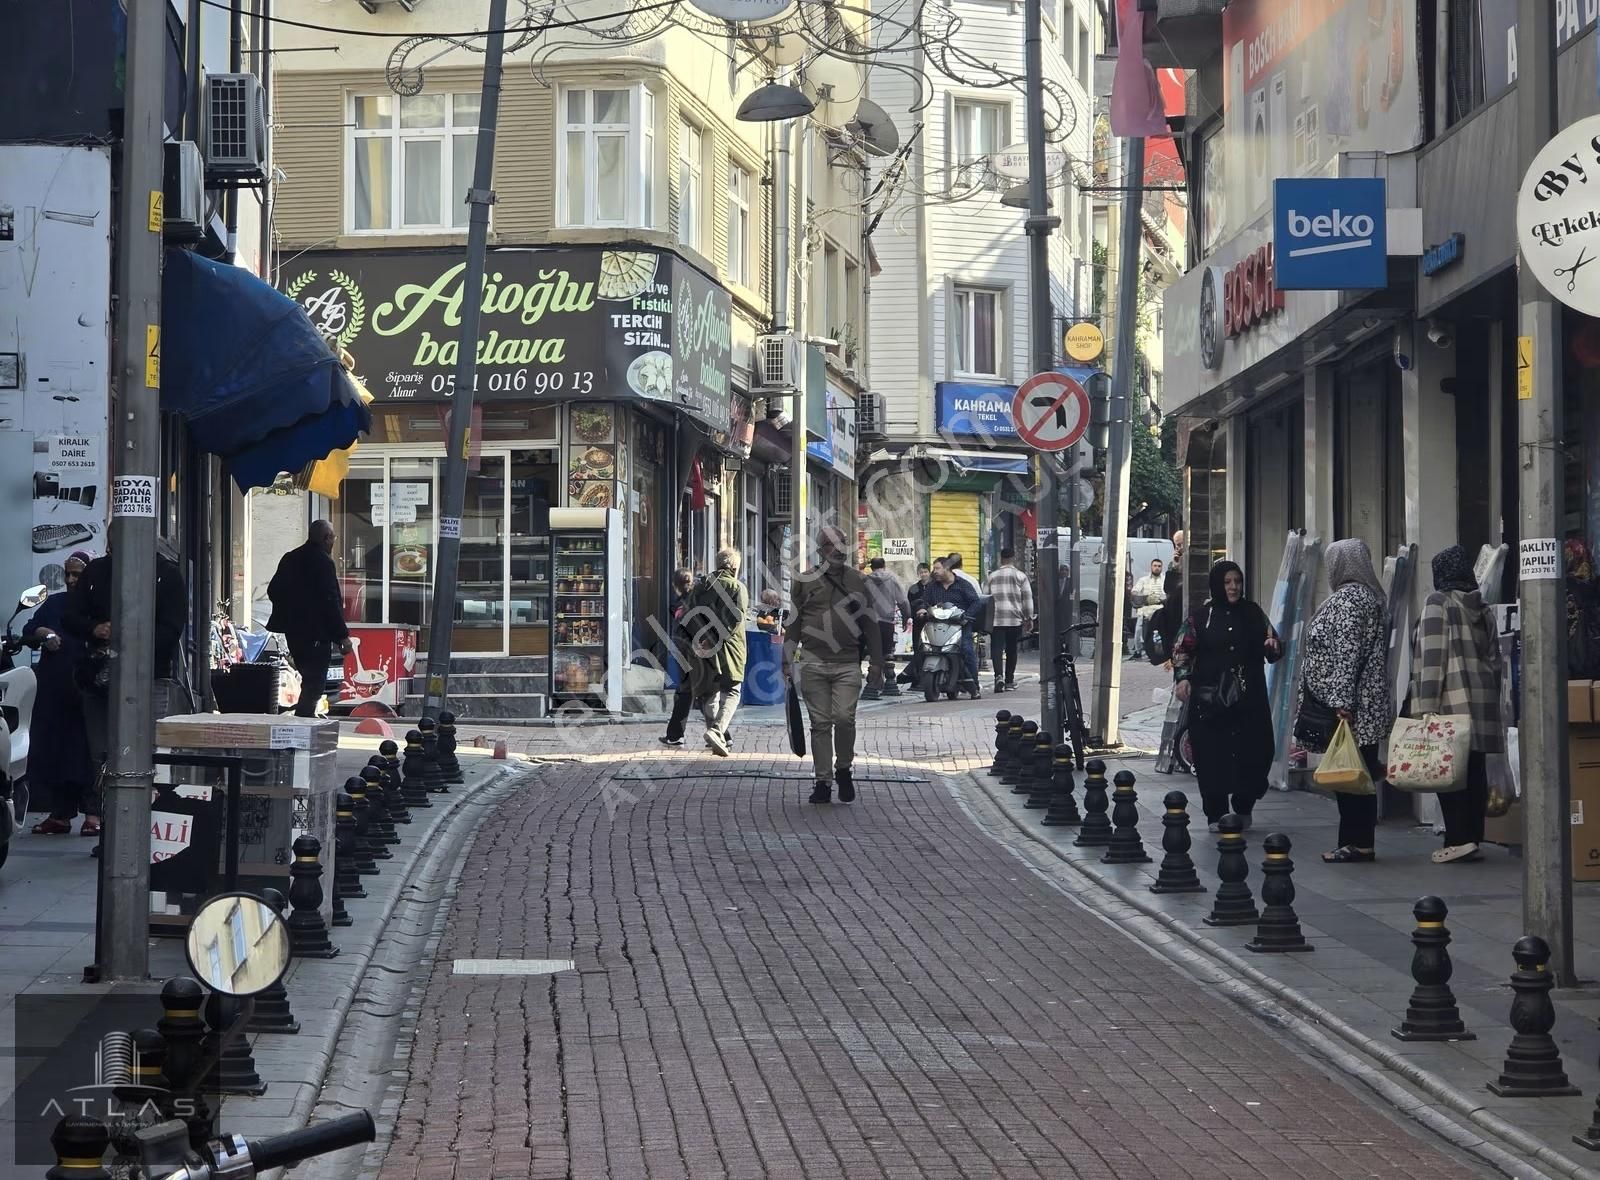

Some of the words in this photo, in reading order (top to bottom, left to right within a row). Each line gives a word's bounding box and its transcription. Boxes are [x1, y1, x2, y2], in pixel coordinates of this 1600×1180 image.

[1249, 23, 1276, 80] BOSCH
[1534, 153, 1588, 203] By
[1288, 208, 1374, 237] beko
[1224, 242, 1276, 337] BOSCH
[371, 262, 595, 336] Aioğlu
[1066, 335, 1101, 343] KAHRAMAN
[385, 371, 424, 387] Sipariş
[431, 373, 478, 397] 051
[488, 369, 527, 392] 016
[535, 371, 564, 395] 90
[571, 371, 594, 394] 13
[954, 398, 1012, 413] KAHRAMA
[977, 413, 998, 421] TEKEL
[58, 436, 90, 447] KİRALIK
[61, 447, 87, 458] DAİRE
[51, 460, 67, 468] 0507
[67, 460, 80, 468] 653
[114, 479, 152, 488] BOYA
[114, 488, 152, 497] BADANA
[114, 495, 151, 504] YAPILIR
[123, 504, 136, 513] 233
[136, 504, 145, 513] 76
